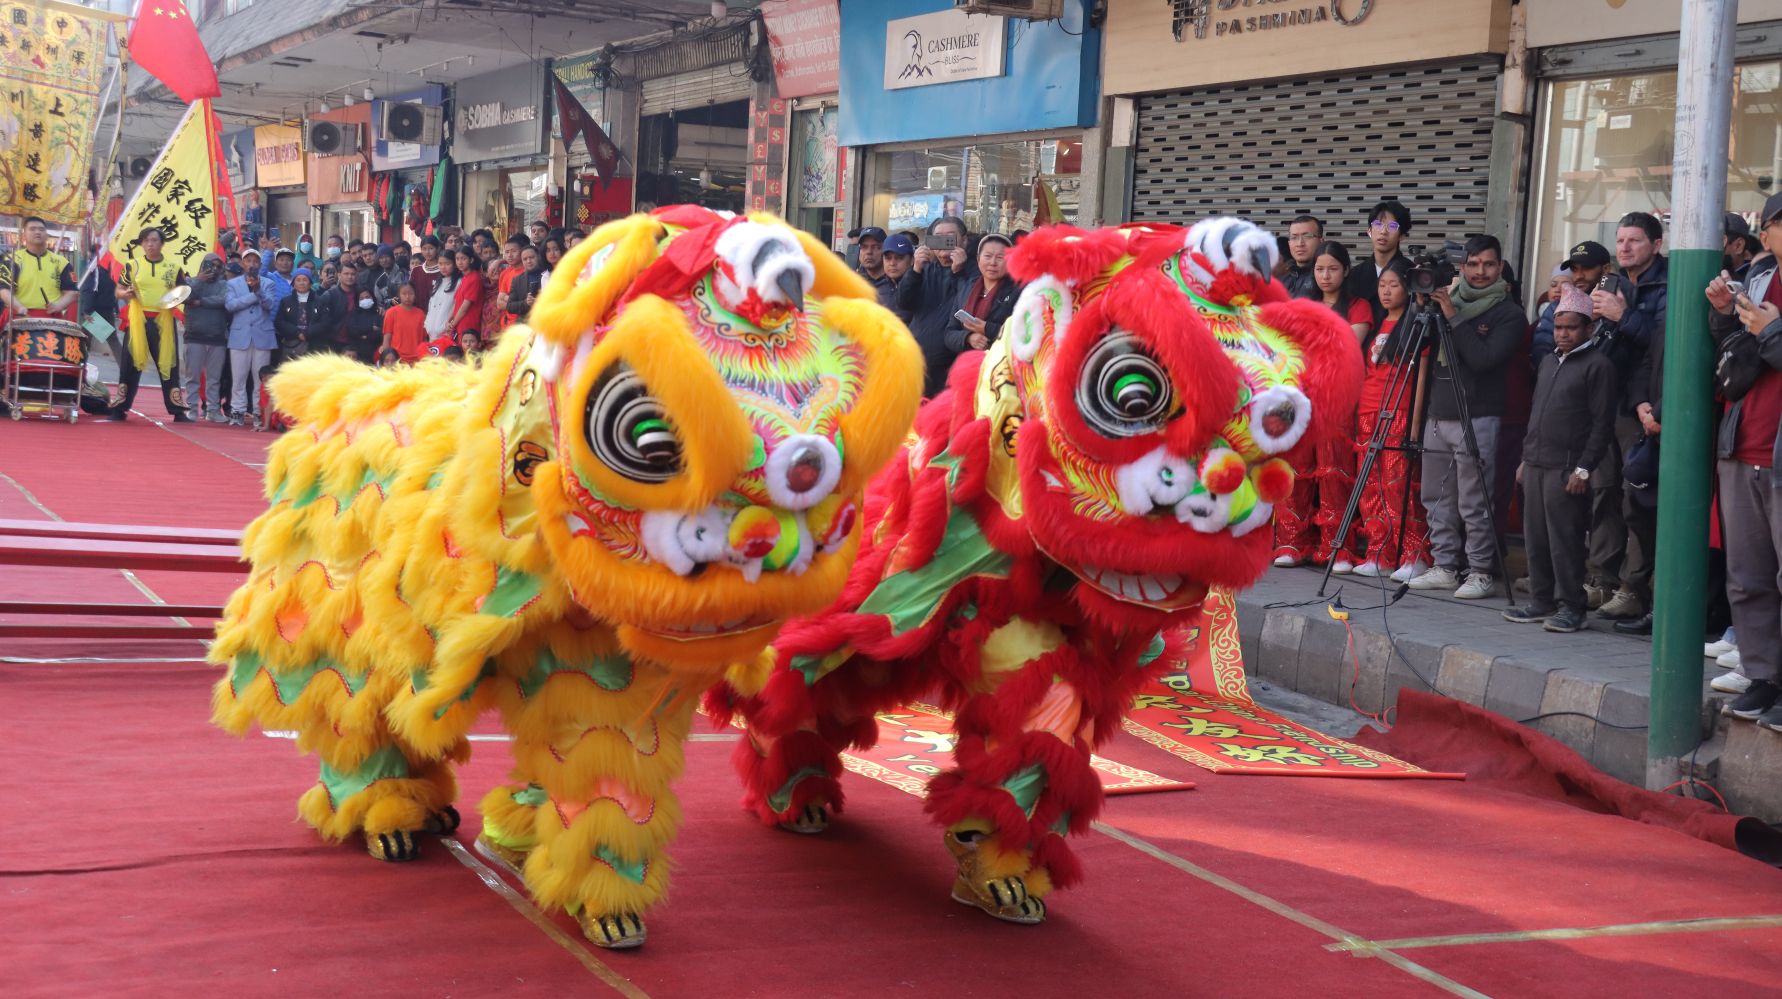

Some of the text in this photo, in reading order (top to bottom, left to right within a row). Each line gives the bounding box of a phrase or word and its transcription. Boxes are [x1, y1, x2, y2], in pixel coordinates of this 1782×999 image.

[1215, 6, 1328, 37] PASHMINA
[927, 32, 980, 54] CASHMERE
[944, 54, 960, 66] BLISS
[467, 101, 536, 130] SOBHA CASHMERE
[341, 162, 361, 192] KNIT
